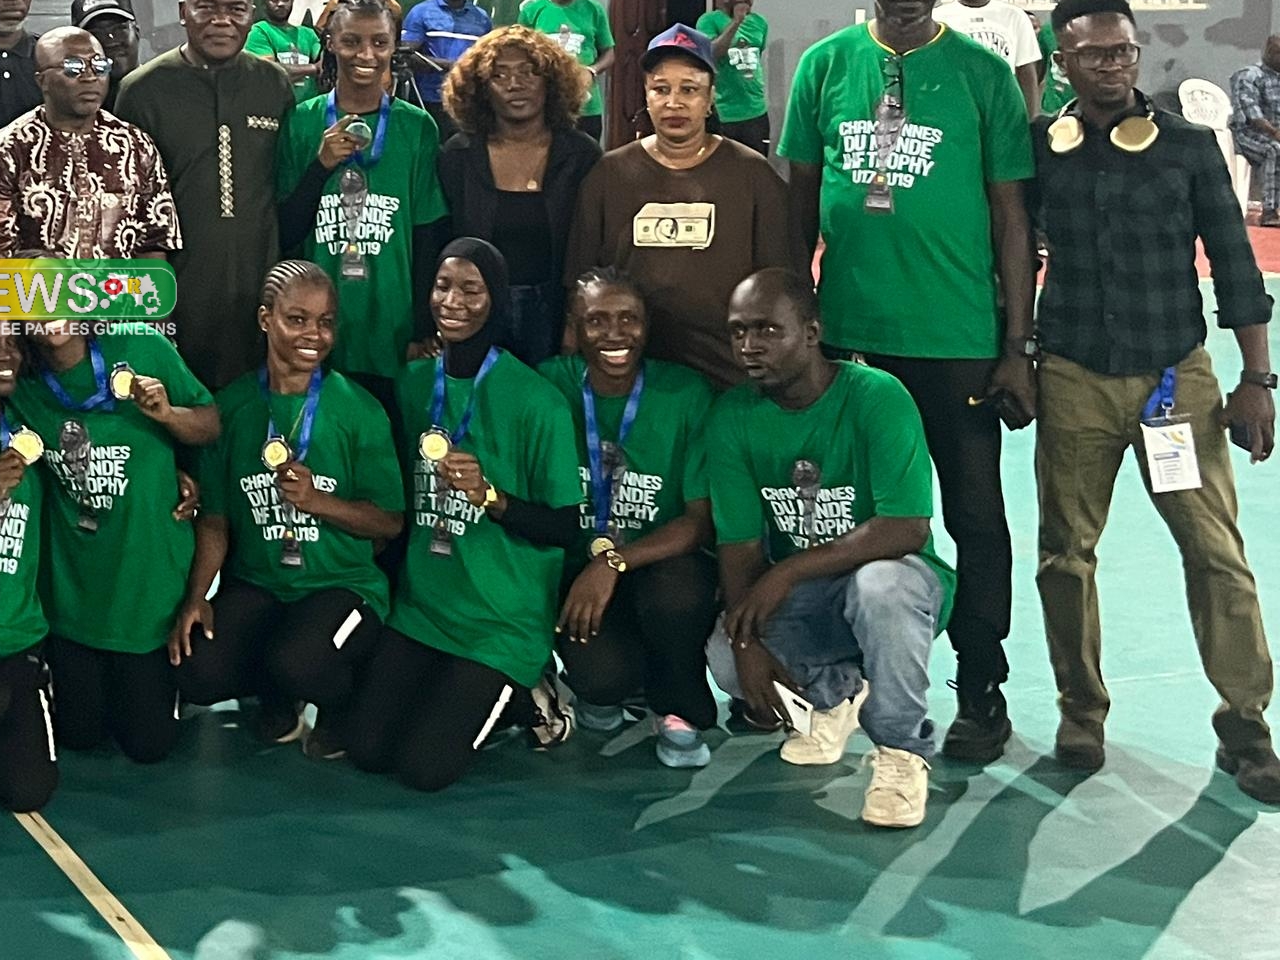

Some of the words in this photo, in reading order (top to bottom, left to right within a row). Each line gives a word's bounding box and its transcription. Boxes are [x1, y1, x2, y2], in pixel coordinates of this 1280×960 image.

[844, 134, 867, 152] DU
[852, 170, 877, 184] U17
[886, 172, 915, 188] U19
[317, 207, 337, 227] DU
[315, 224, 337, 243] IHF
[328, 241, 349, 255] U7
[357, 241, 381, 255] U19
[90, 496, 113, 510] U19
[247, 488, 269, 507] DU
[770, 500, 797, 516] DU
[416, 512, 439, 528] U17
[263, 525, 286, 540] U17
[294, 526, 319, 542] U19
